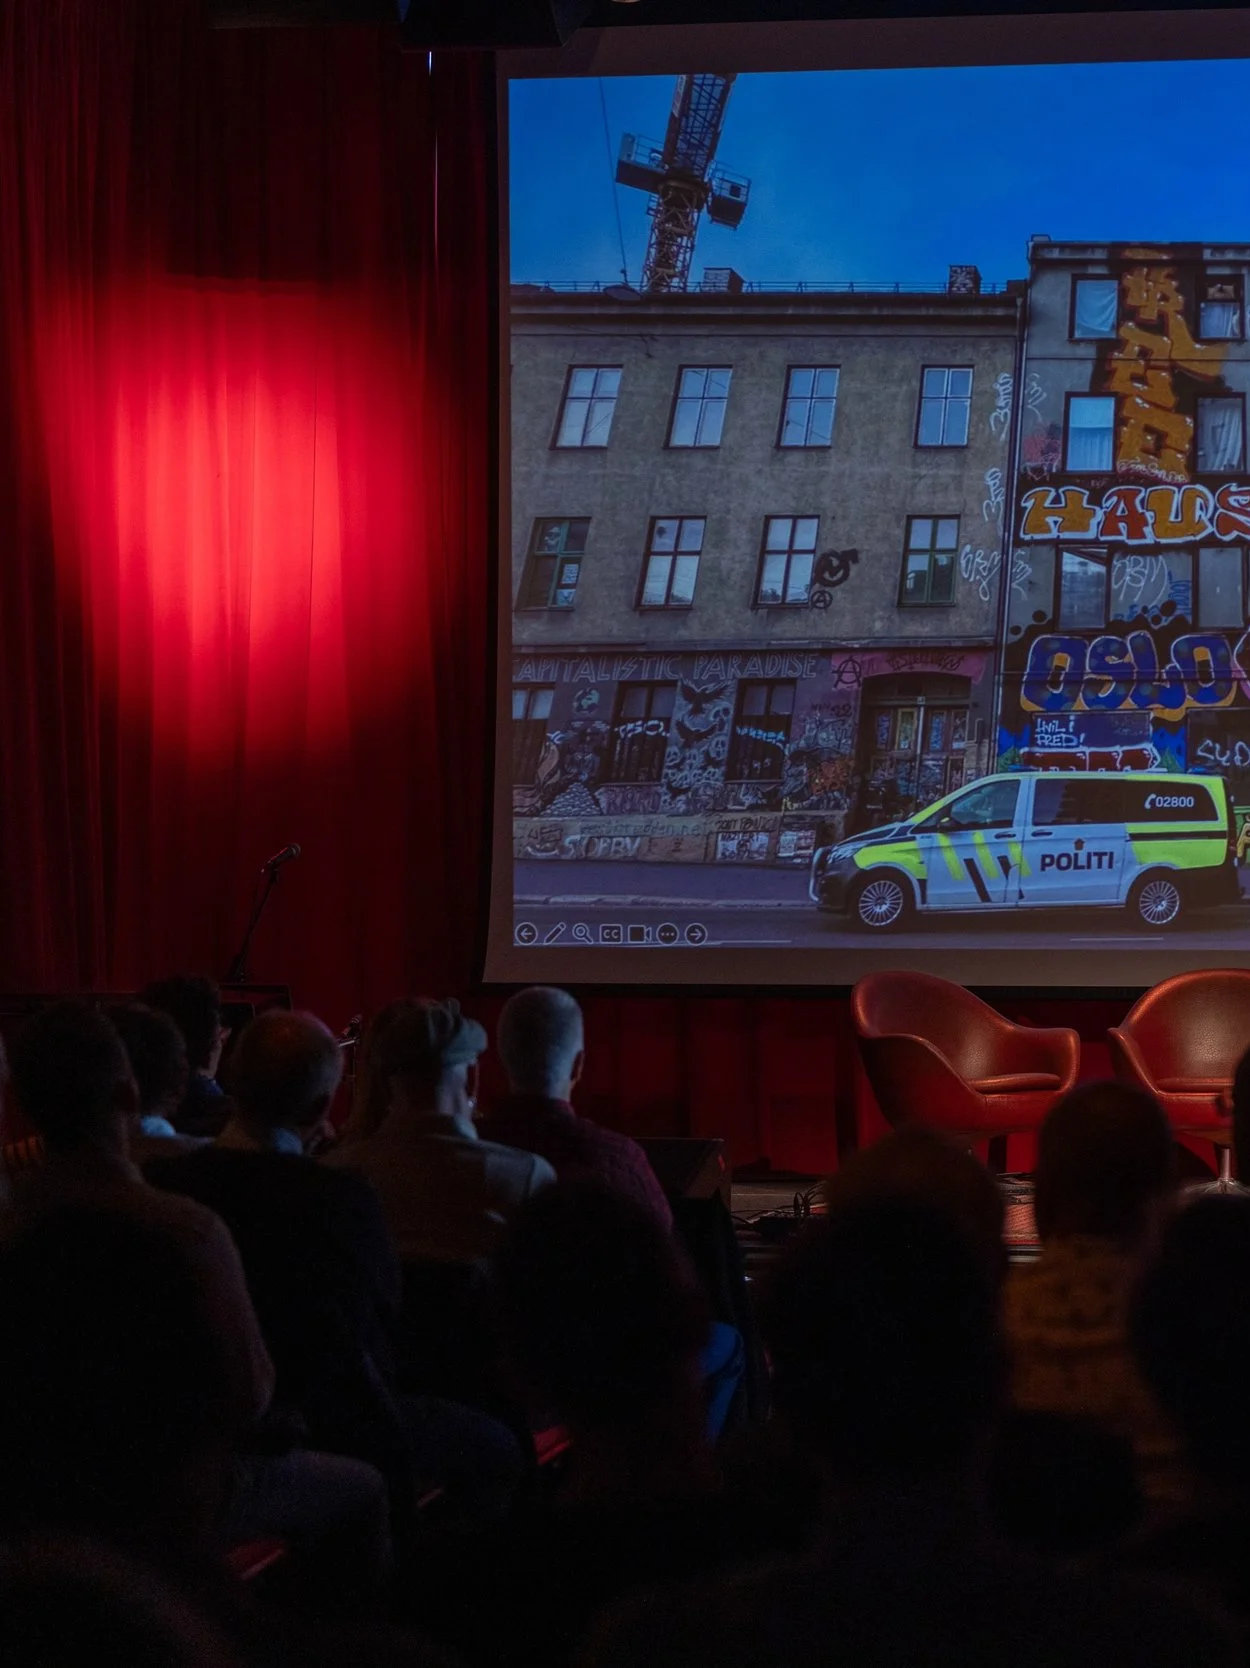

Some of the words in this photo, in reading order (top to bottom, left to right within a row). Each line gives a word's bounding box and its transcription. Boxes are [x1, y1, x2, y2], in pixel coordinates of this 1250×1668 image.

[512, 654, 682, 684] APITALISTIC
[691, 652, 819, 681] PARADISE
[1021, 631, 1237, 714] OSLO
[1155, 796, 1195, 808] 02800
[1040, 850, 1115, 872] POLITI
[603, 929, 618, 938] CC
